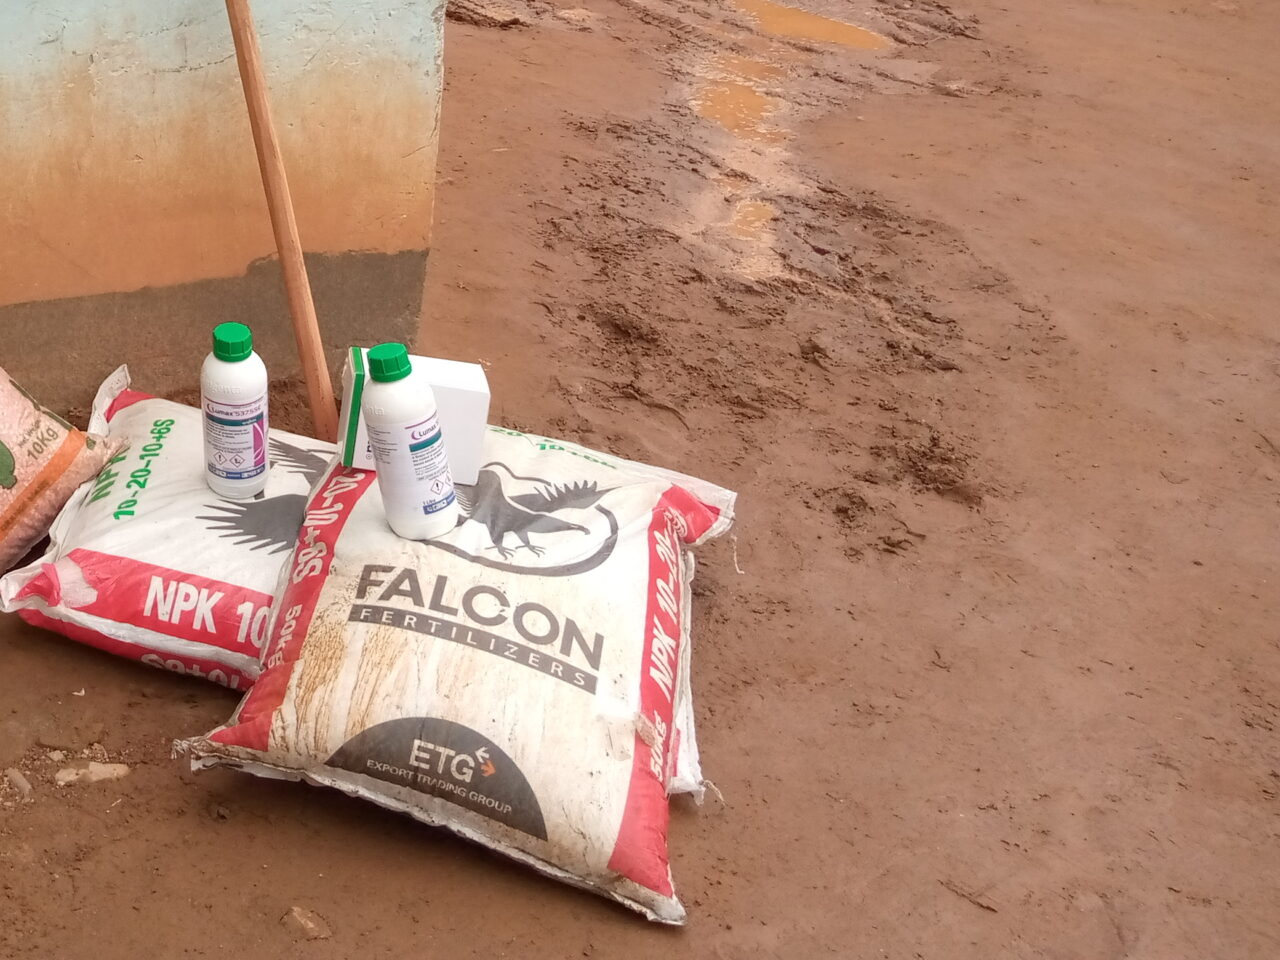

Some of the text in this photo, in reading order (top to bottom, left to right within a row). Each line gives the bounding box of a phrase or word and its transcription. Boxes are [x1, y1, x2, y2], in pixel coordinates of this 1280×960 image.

[27, 426, 58, 460] 10Kg
[113, 419, 175, 520] 10-20-10+6S
[143, 575, 224, 634] NPK
[355, 564, 604, 671] FALCON
[359, 608, 586, 687] FERTILIZERS
[649, 618, 677, 704] NPK
[367, 759, 512, 814] EXPORT TRADING GROUP
[409, 738, 476, 783] ETG
